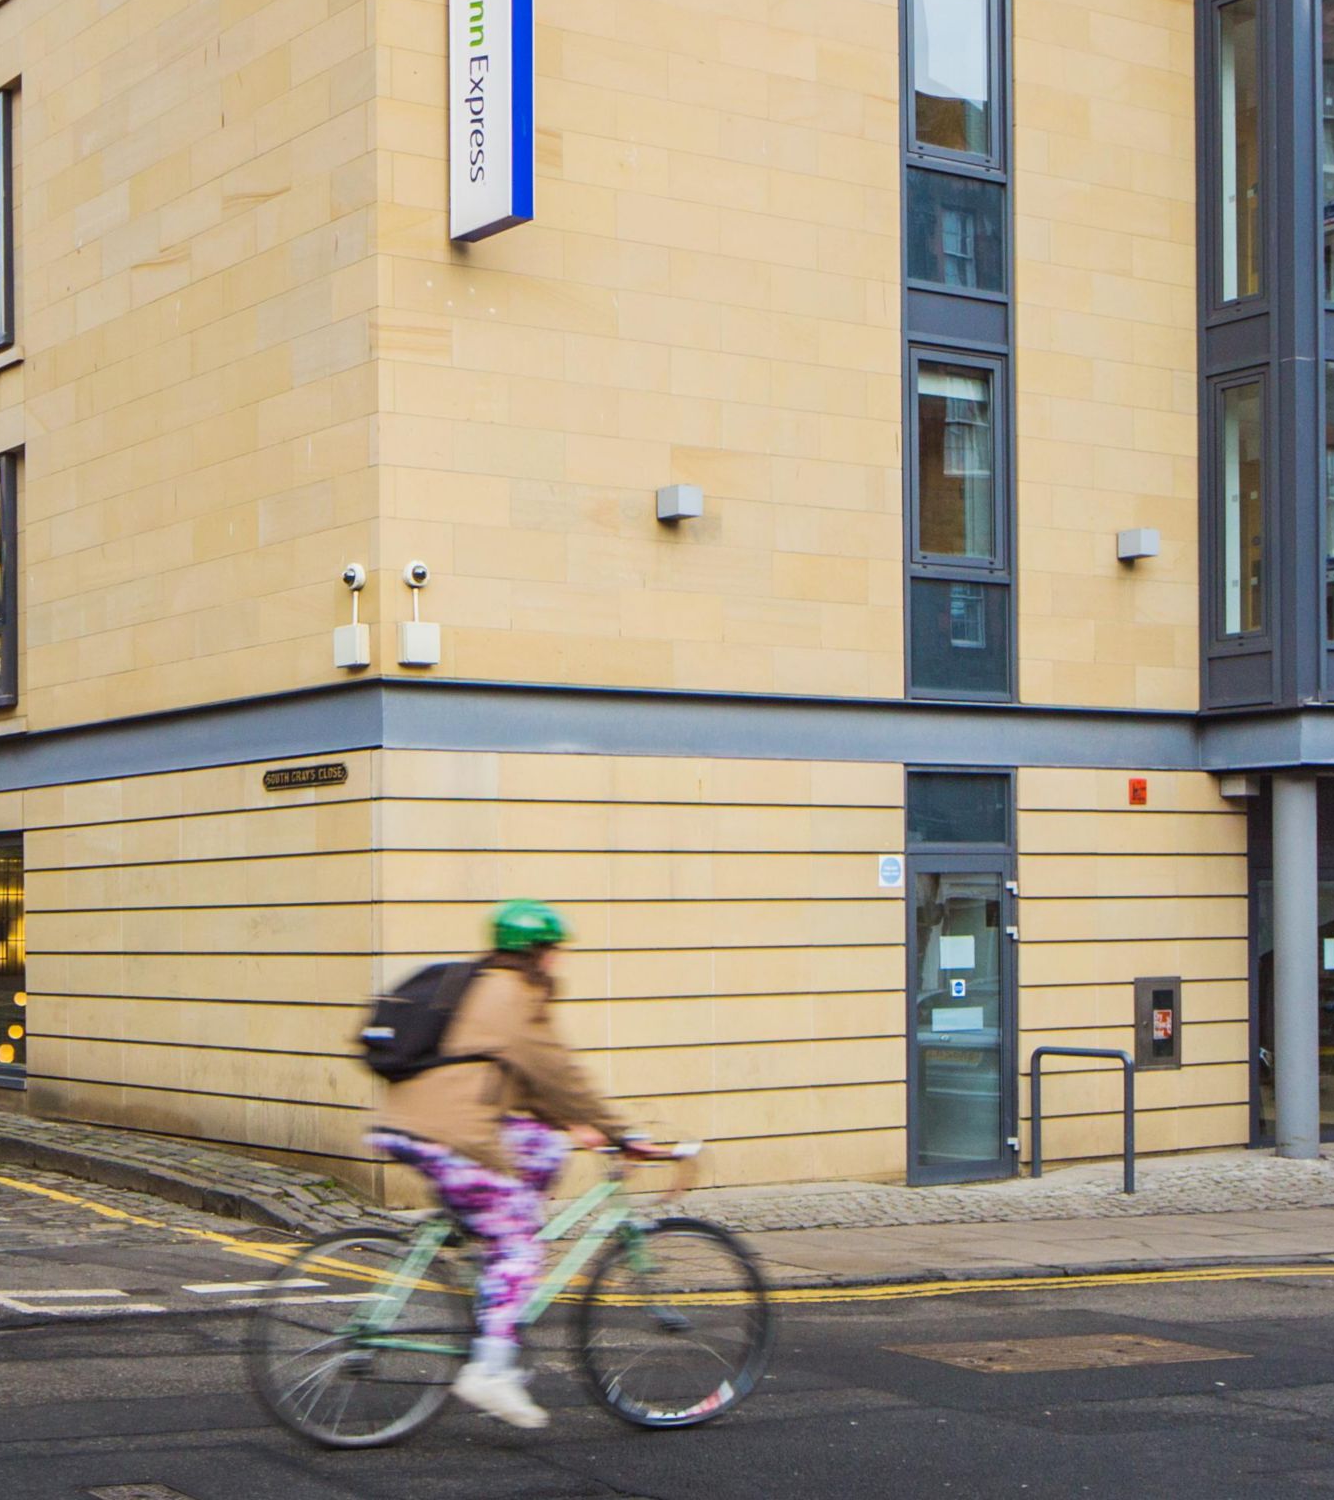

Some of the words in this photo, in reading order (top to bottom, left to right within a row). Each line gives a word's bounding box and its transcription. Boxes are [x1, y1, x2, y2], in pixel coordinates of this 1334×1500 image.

[463, 54, 489, 184] Express
[266, 771, 290, 785] SOUTH
[318, 766, 343, 780] CLOSE
